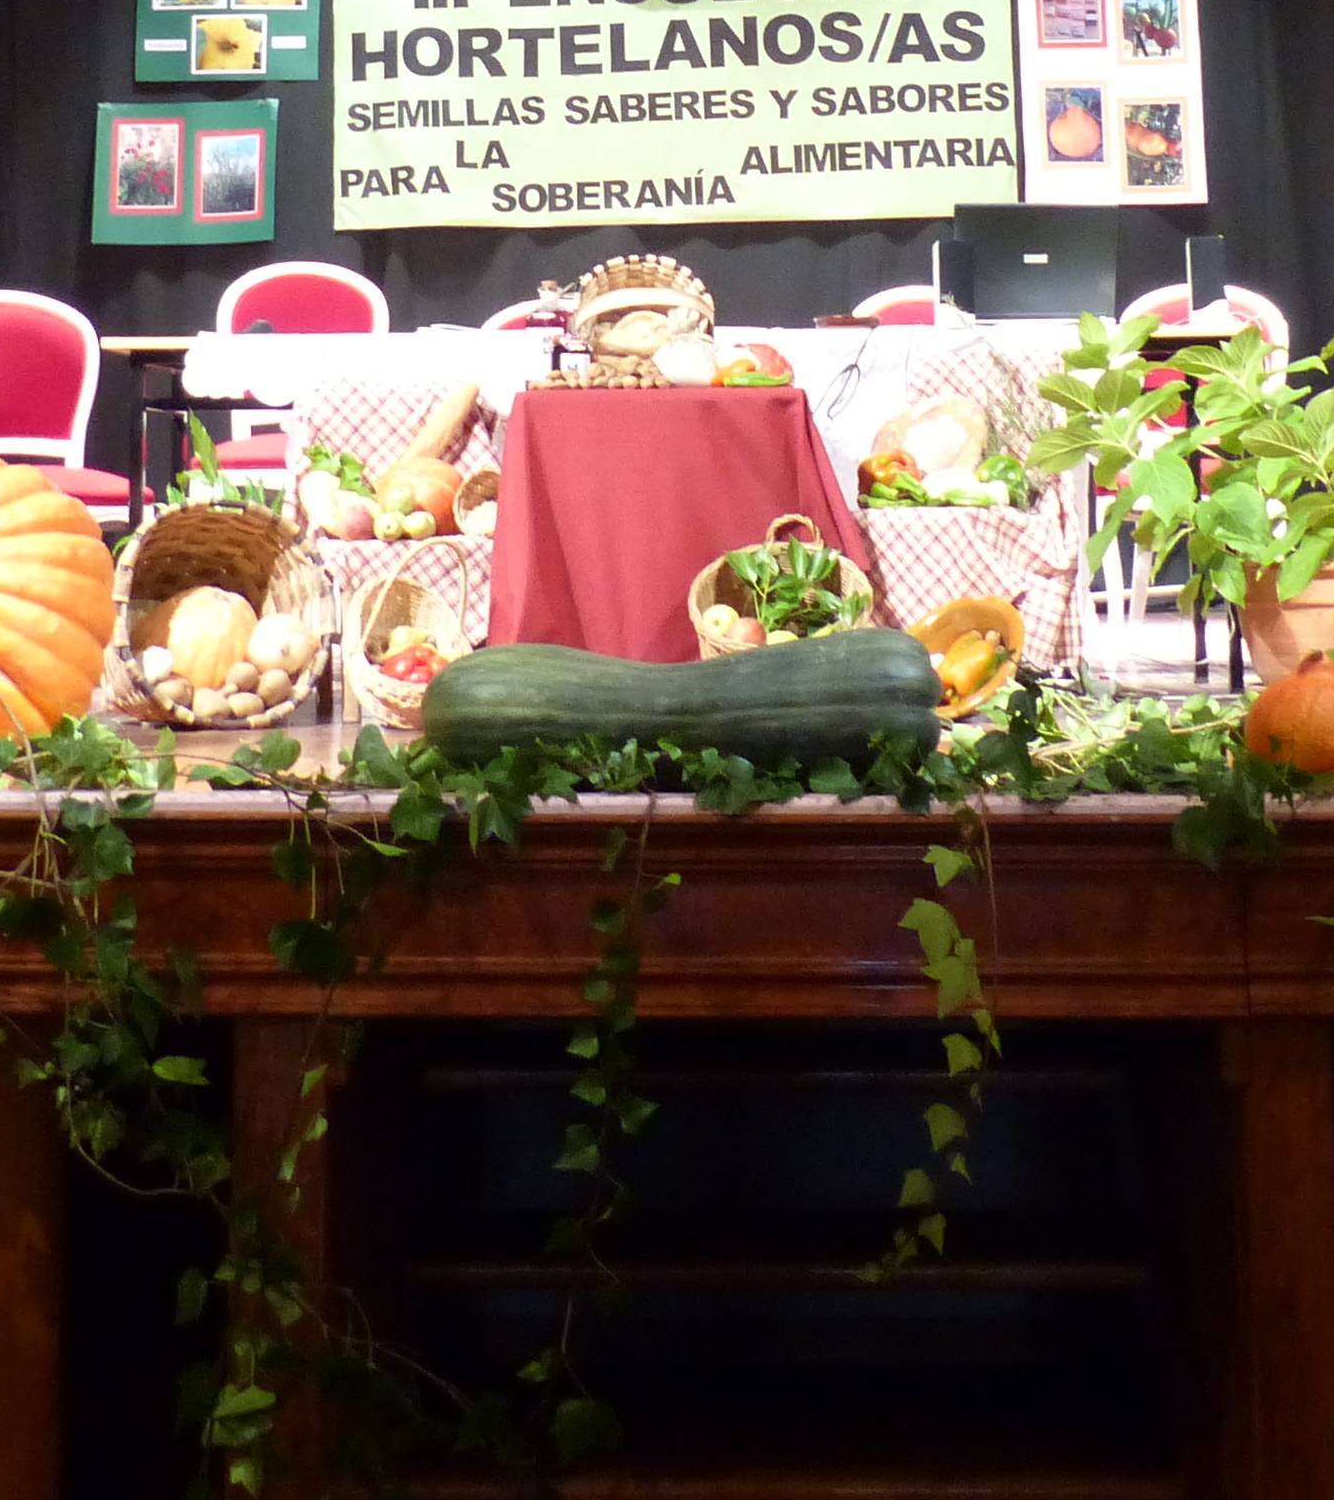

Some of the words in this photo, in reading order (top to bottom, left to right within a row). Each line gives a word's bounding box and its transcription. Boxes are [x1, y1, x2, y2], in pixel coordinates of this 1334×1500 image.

[352, 11, 985, 82] HORTELANOS/AS
[347, 96, 545, 132] SEMILLAS
[564, 91, 754, 125] SABERES
[770, 90, 797, 118] Y
[812, 83, 1009, 116] SABORES
[340, 166, 449, 198] PARA
[455, 141, 510, 169] LA
[492, 169, 735, 213] SOBERANÍA
[741, 138, 1015, 174] ALIMENTARIA
